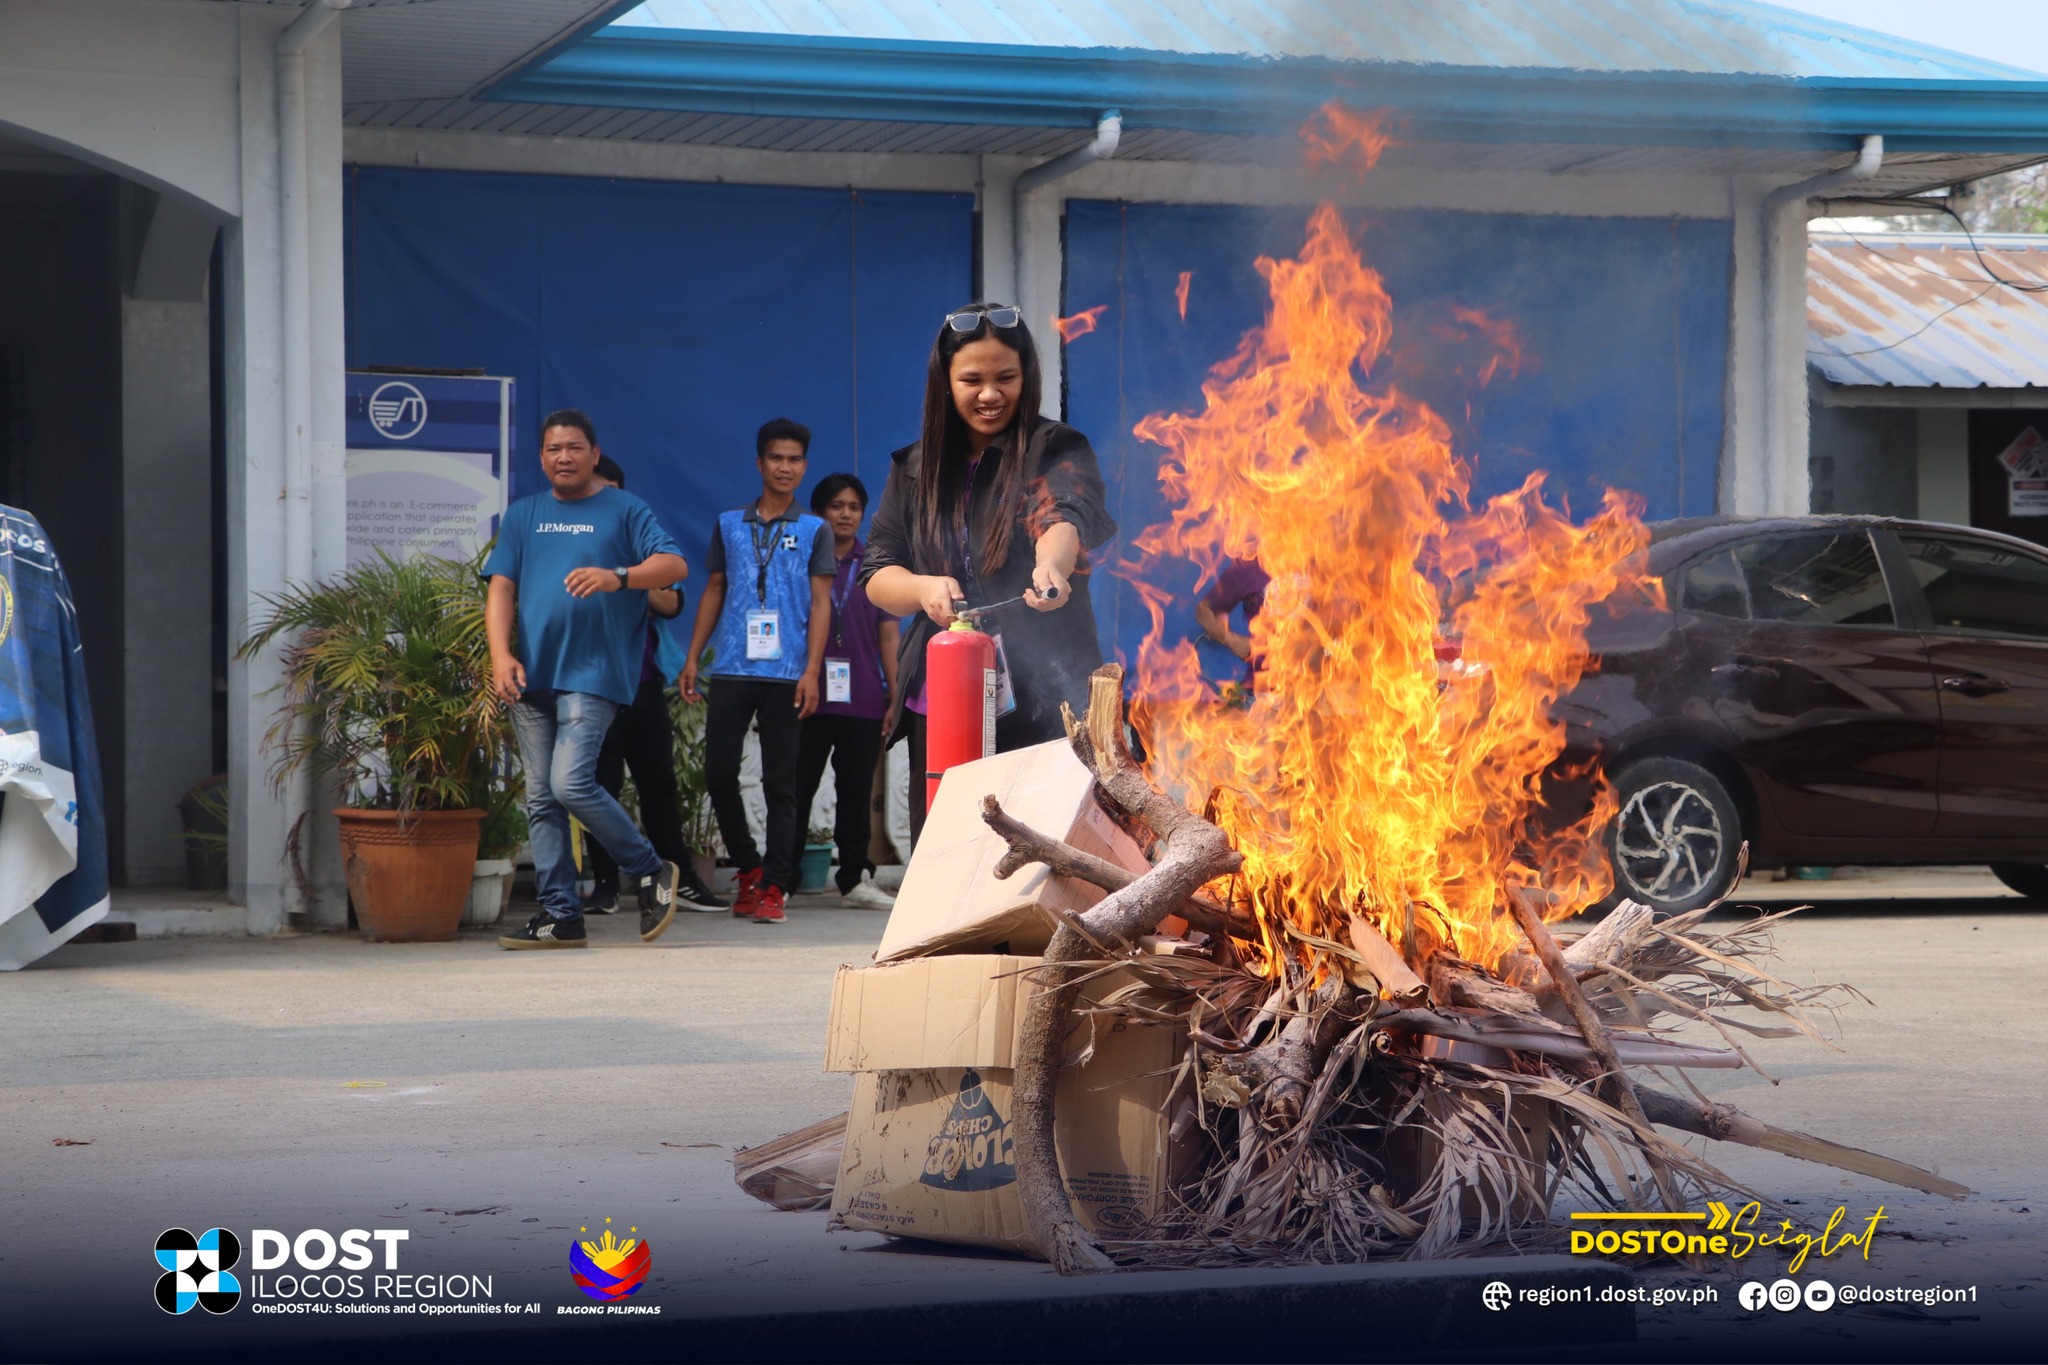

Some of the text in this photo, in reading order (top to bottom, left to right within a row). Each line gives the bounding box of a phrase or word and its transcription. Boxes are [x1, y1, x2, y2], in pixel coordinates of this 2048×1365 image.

[379, 500, 387, 509] is
[389, 501, 404, 509] an
[409, 500, 478, 512] E-commerce
[347, 511, 477, 525] pplication that operates
[346, 523, 479, 538] wide and caters primarily
[1068, 1192, 1118, 1203] CORPORATI
